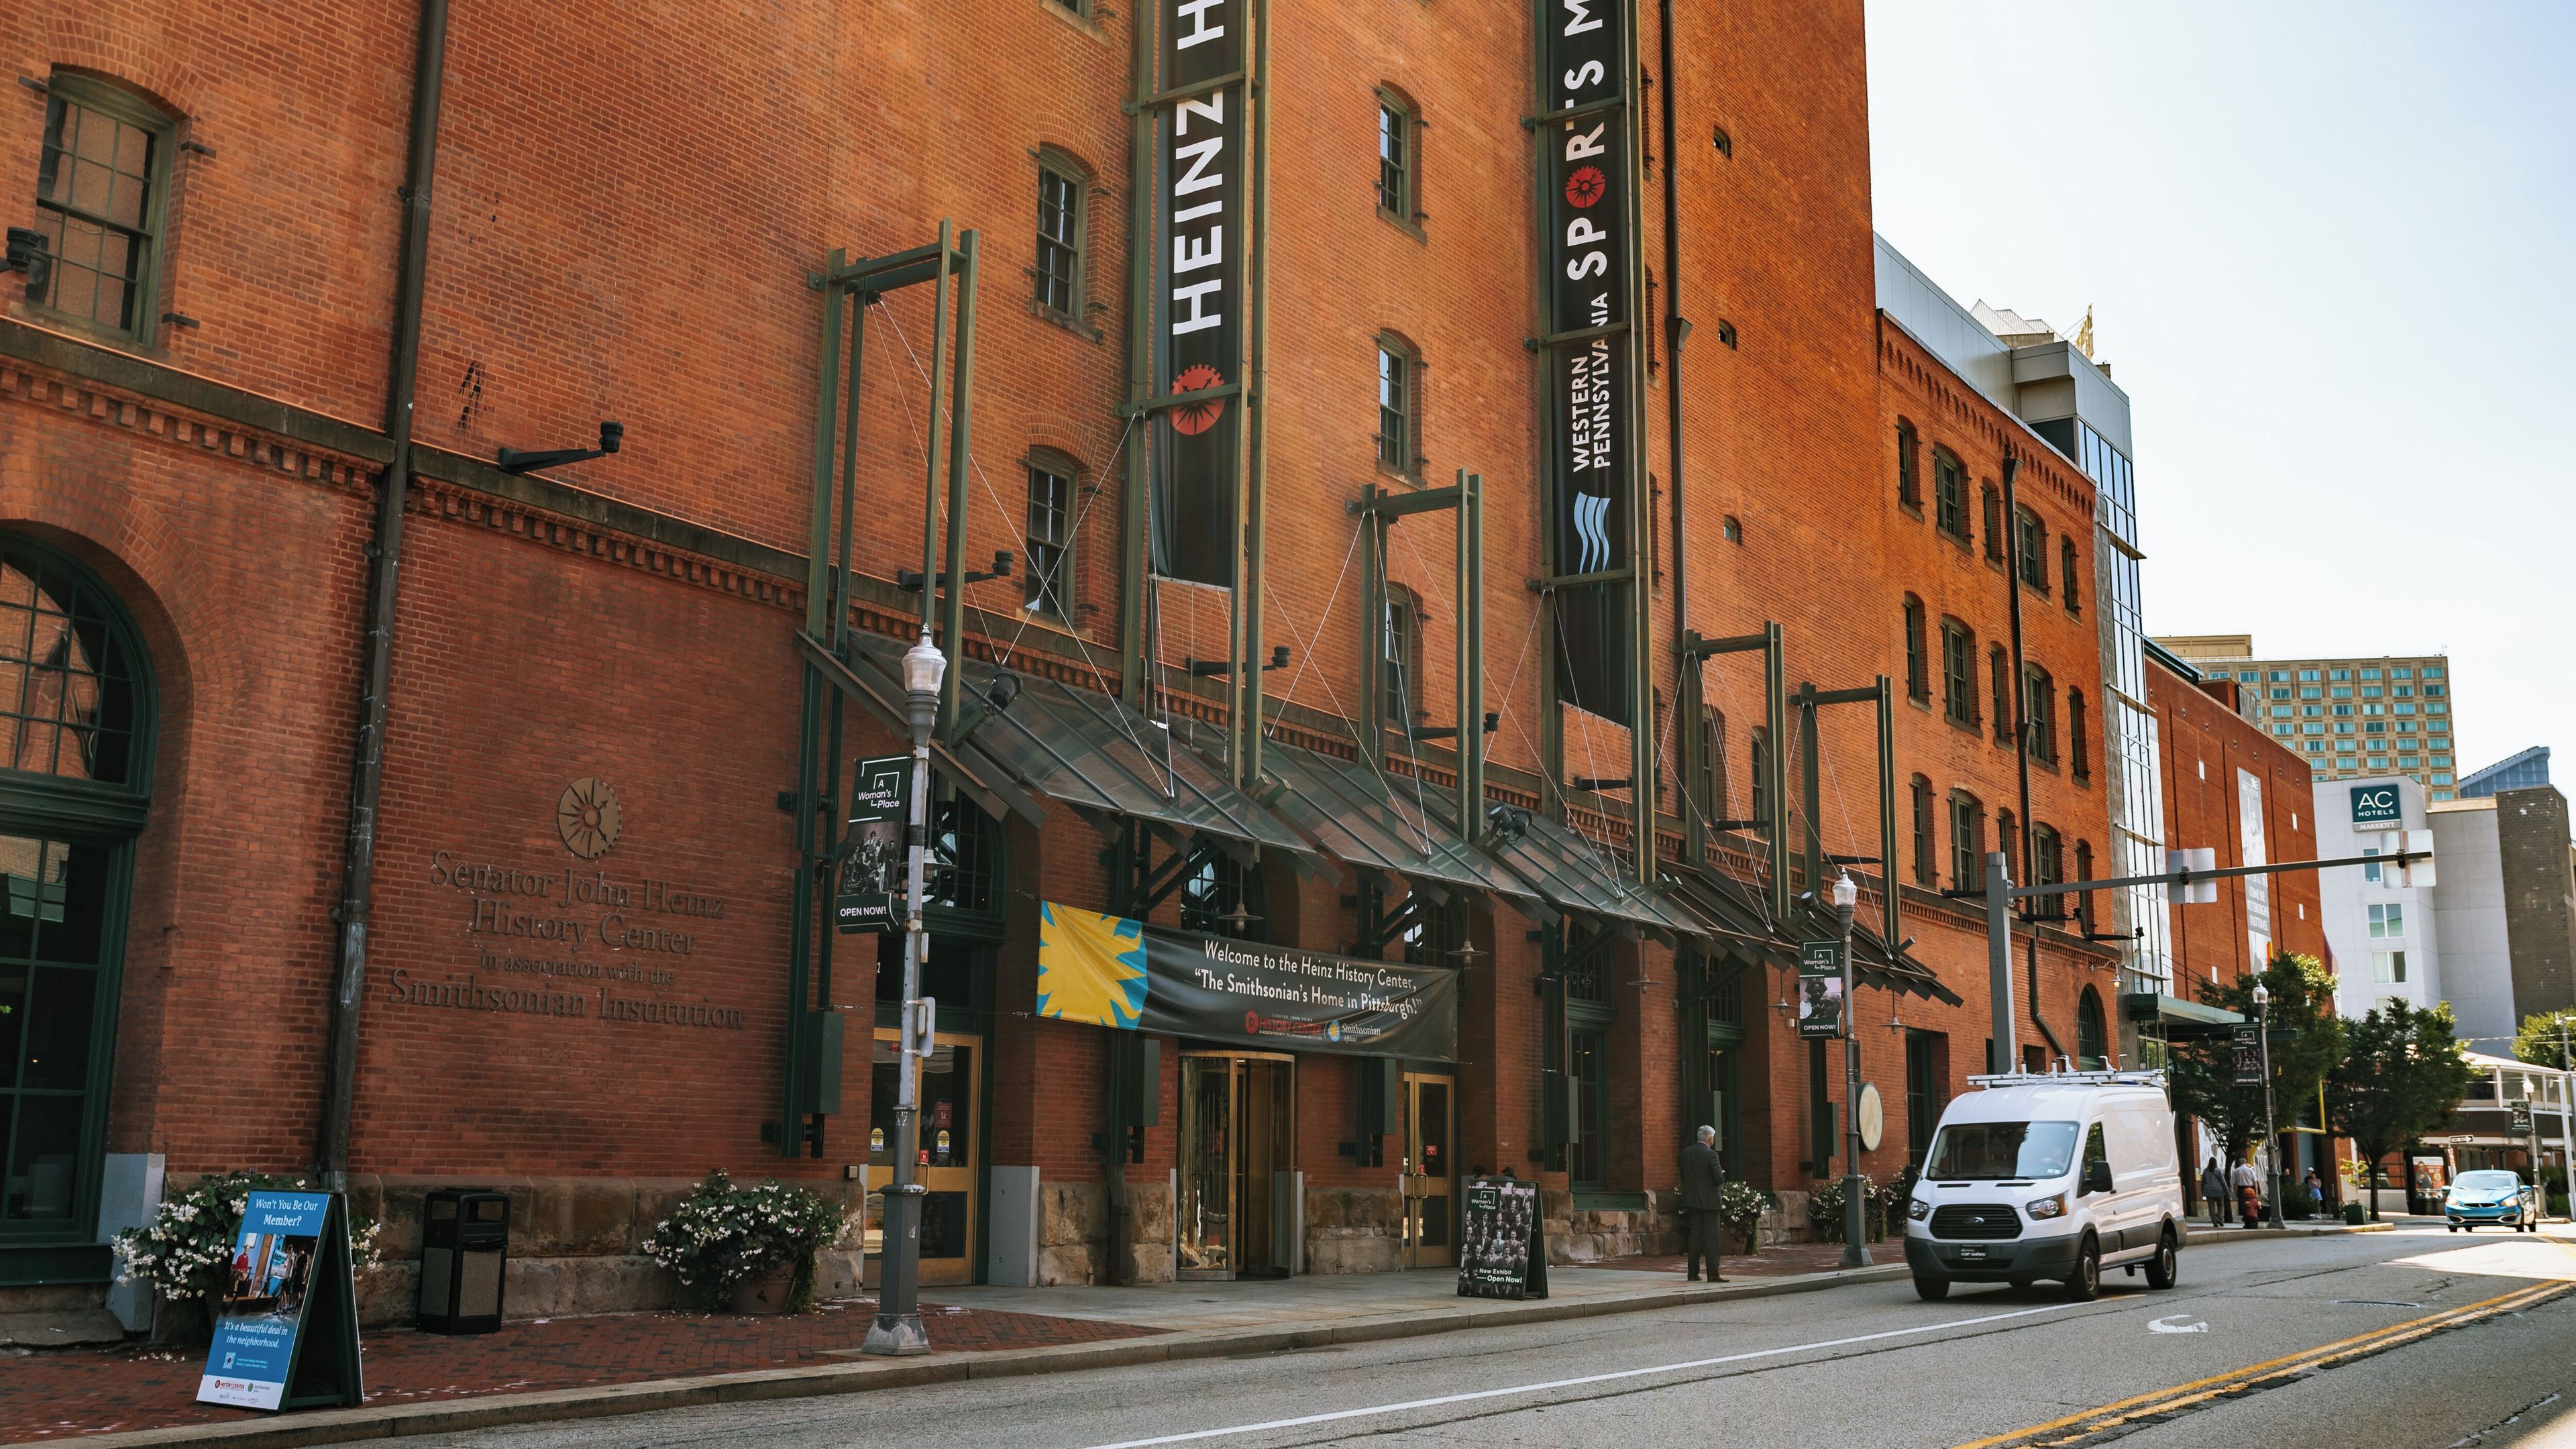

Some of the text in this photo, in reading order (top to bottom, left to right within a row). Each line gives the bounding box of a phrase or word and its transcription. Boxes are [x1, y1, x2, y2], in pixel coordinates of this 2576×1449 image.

[1173, 89, 1223, 335] HEINZ
[1571, 356, 1590, 472] WESTERN
[878, 779, 884, 788] A
[859, 789, 892, 800] Woman's
[2358, 791, 2393, 809] AC
[877, 800, 900, 808] Place
[2360, 822, 2395, 830] MARRIOTT
[432, 849, 725, 919] Senator John Heinz
[840, 906, 887, 917] OPEN NOW!
[470, 898, 697, 955] History Center
[480, 948, 676, 985] in association with the
[1205, 939, 1417, 993] Welcome to the Heinz History Center,
[1227, 973, 1308, 1003] Smithsonian's
[1311, 985, 1344, 1008] Home
[1347, 991, 1358, 1009] in
[390, 968, 743, 1030] Smithsonian Institution
[1259, 1018, 1292, 1032] HISTORY
[1342, 1022, 1381, 1036] Smithsonian
[256, 1198, 318, 1211] Won't You Be Our
[263, 1214, 302, 1226] Member?
[225, 1321, 234, 1330] It's
[239, 1322, 268, 1335] beautiful
[268, 1326, 281, 1334] deal
[280, 1327, 288, 1336] in
[226, 1334, 279, 1348] the neighborhood.
